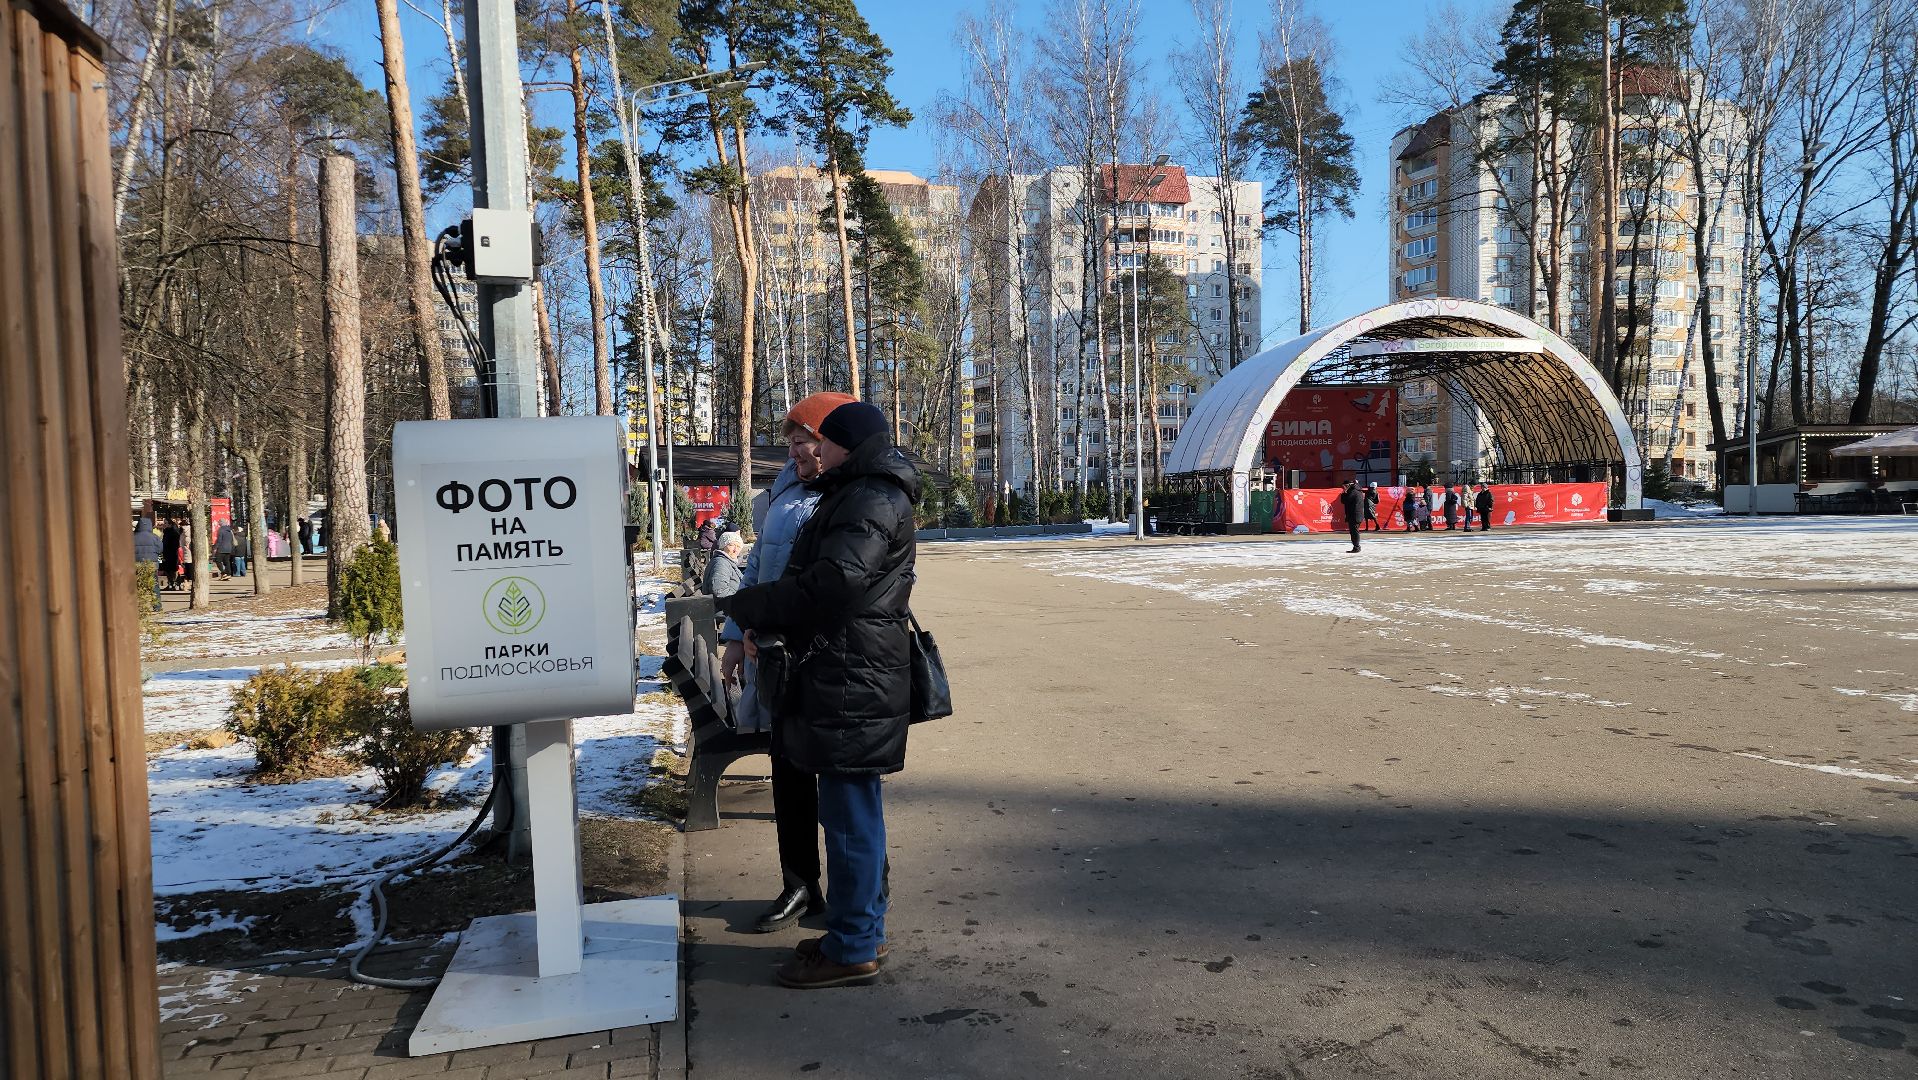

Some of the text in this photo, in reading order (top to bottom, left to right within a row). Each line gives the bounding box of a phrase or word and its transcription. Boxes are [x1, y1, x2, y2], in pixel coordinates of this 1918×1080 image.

[1270, 419, 1333, 437] ЗИМА
[1277, 438, 1333, 447] ПОДМОСКОВЬЕ
[435, 476, 578, 514] ФОТО
[491, 517, 527, 536] НА
[456, 539, 565, 562] ПАМЯТЬ
[484, 642, 550, 660] ПАРКИ
[441, 656, 594, 681] ПОДМОСКОВЬЯ
